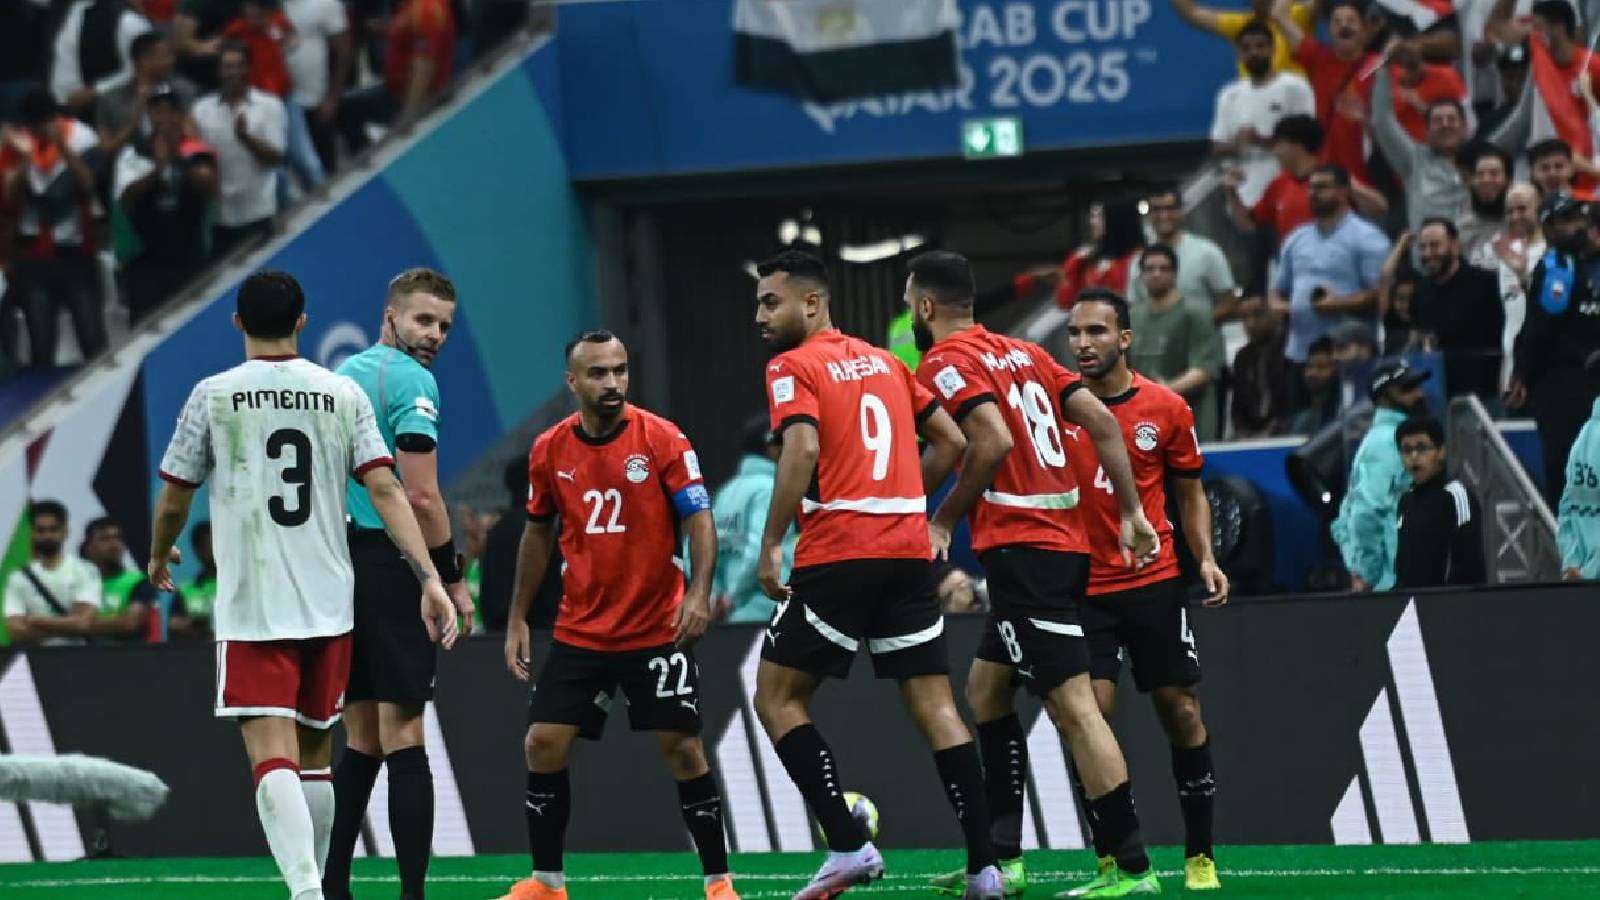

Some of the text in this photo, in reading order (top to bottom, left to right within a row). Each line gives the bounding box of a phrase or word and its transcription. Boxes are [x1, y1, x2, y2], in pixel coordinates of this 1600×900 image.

[960, 0, 1150, 49] AB CUP
[989, 50, 1130, 107] 2025
[232, 388, 335, 413] PIMENTA
[860, 392, 892, 481] 9
[1007, 379, 1067, 471] 18
[266, 427, 312, 527] 3
[1094, 463, 1114, 496] 4
[583, 488, 626, 534] 22
[997, 620, 1023, 664] 8
[1180, 607, 1195, 650] 4
[648, 652, 693, 698] 22
